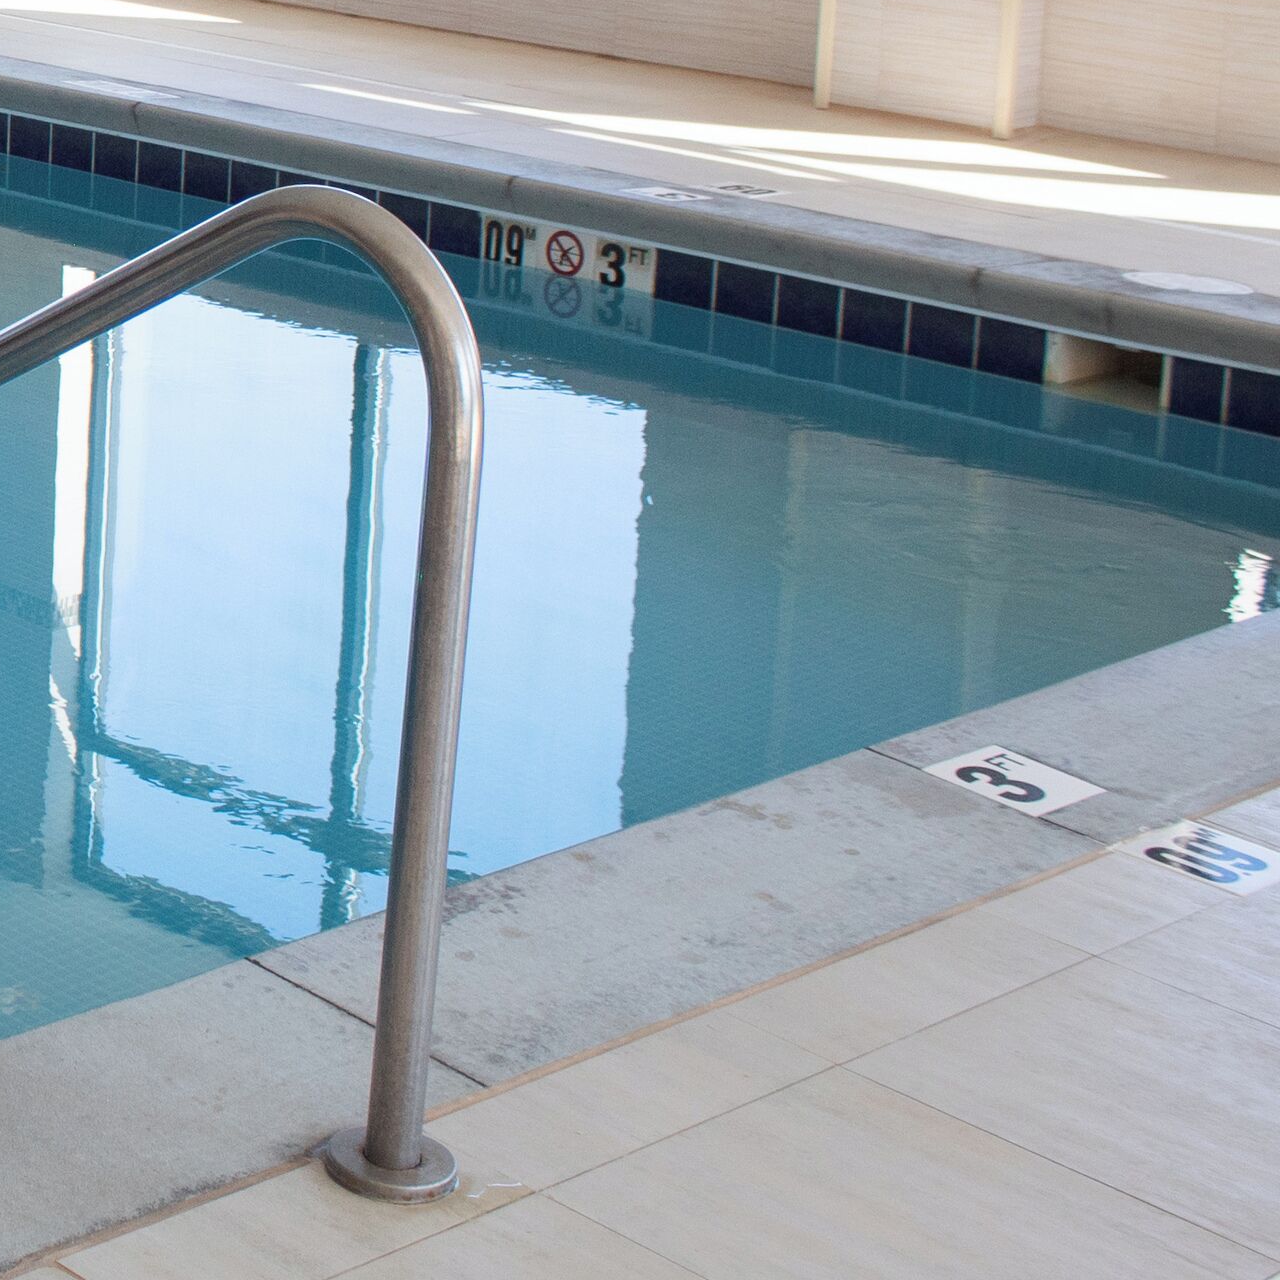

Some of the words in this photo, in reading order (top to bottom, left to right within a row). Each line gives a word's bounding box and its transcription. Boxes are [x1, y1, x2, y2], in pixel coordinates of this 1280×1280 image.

[599, 242, 625, 288] 3
[626, 246, 649, 265] FT
[983, 752, 1028, 771] FT
[956, 765, 1046, 803] 3
